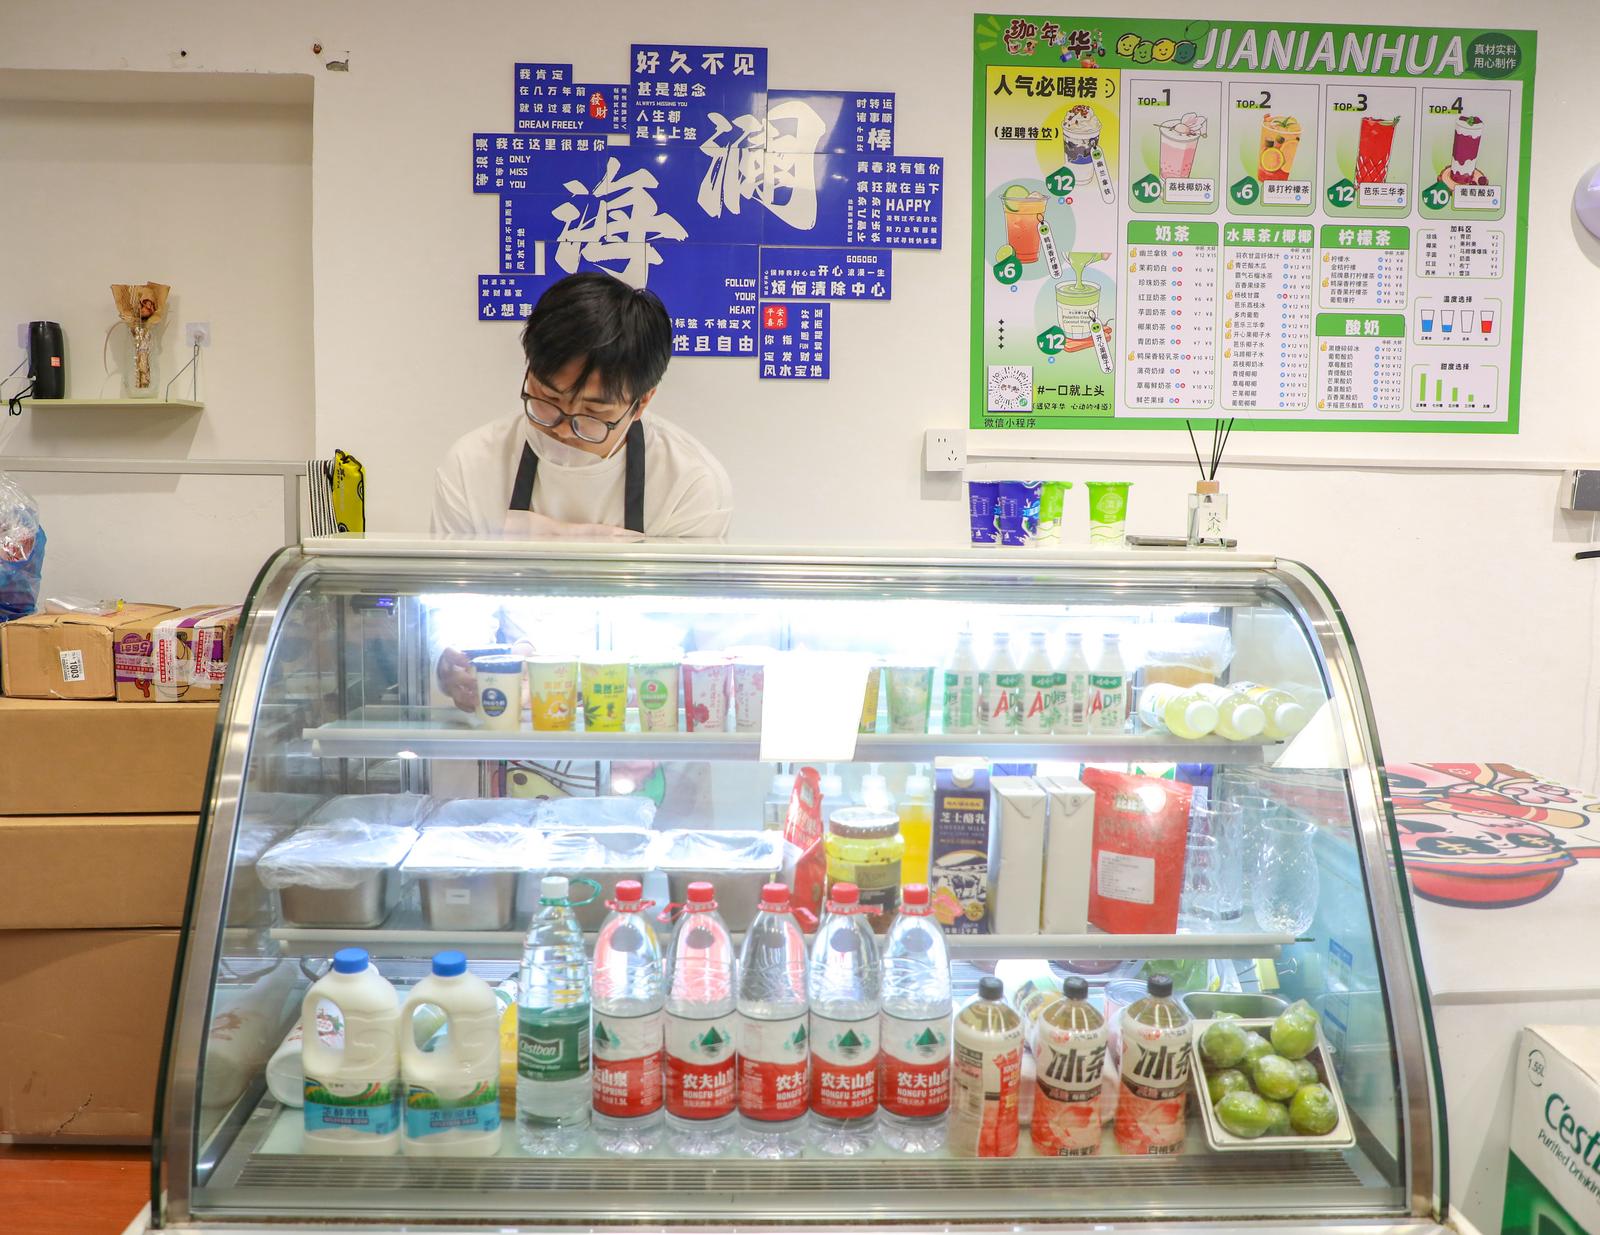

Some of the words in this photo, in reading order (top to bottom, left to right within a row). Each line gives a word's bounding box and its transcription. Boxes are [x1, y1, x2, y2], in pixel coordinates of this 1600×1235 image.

[1193, 28, 1465, 77] JIANIANHUA
[1474, 44, 1517, 57] 真材实料
[635, 50, 755, 76] 好久不见
[1474, 57, 1517, 70] 用心制作
[519, 68, 563, 80] 我肯定
[519, 86, 586, 97] 在几万年前
[637, 82, 706, 97] 甚是想念
[994, 74, 1098, 98] 人气必喝榜
[519, 103, 586, 114] 就说过爱你
[856, 98, 892, 110] 时转运
[636, 110, 681, 123] 人生都
[856, 112, 892, 124] 诸事顺
[518, 120, 550, 129] DREAM
[552, 120, 584, 130] FREELY
[636, 126, 697, 140] 是上上签
[868, 128, 892, 151] 棒
[496, 138, 604, 152] 我在这里很想你
[509, 156, 531, 164] ONLY
[509, 168, 528, 176] MISS
[857, 162, 940, 174] 青春没有售价
[509, 180, 526, 188] YOU
[856, 181, 940, 194] 疯狂就在当下
[1168, 182, 1212, 192] 荔枝椰奶冰
[1268, 184, 1310, 194] 暴打柠檬茶
[1364, 186, 1406, 196] 芭乐三华李
[1460, 188, 1495, 198] 葡萄酸奶
[886, 199, 932, 212] HAPPY
[857, 196, 867, 242] 不管几岁
[871, 196, 881, 242] 快乐万岁
[1156, 225, 1190, 242] 奶茶
[1226, 228, 1312, 243] 水果茶/椰椰
[1338, 229, 1391, 246] 柠檬茶
[818, 265, 843, 276] 开心
[848, 268, 884, 277] 浪漫一生
[725, 278, 756, 288] FOLLOW
[771, 280, 886, 296] 烦恼清除中心
[734, 292, 756, 300] YOUR
[730, 306, 756, 314] HEART
[704, 318, 752, 330] 不被定义
[1346, 320, 1380, 336] 酸奶
[764, 364, 822, 376] 风水宝地
[1037, 384, 1104, 397] #一口就上头
[984, 418, 1036, 428] 微信小程序
[70, 660, 80, 680] 1003
[821, 1071, 875, 1089] 农夫山泉
[1538, 1128, 1570, 1166] Purified
